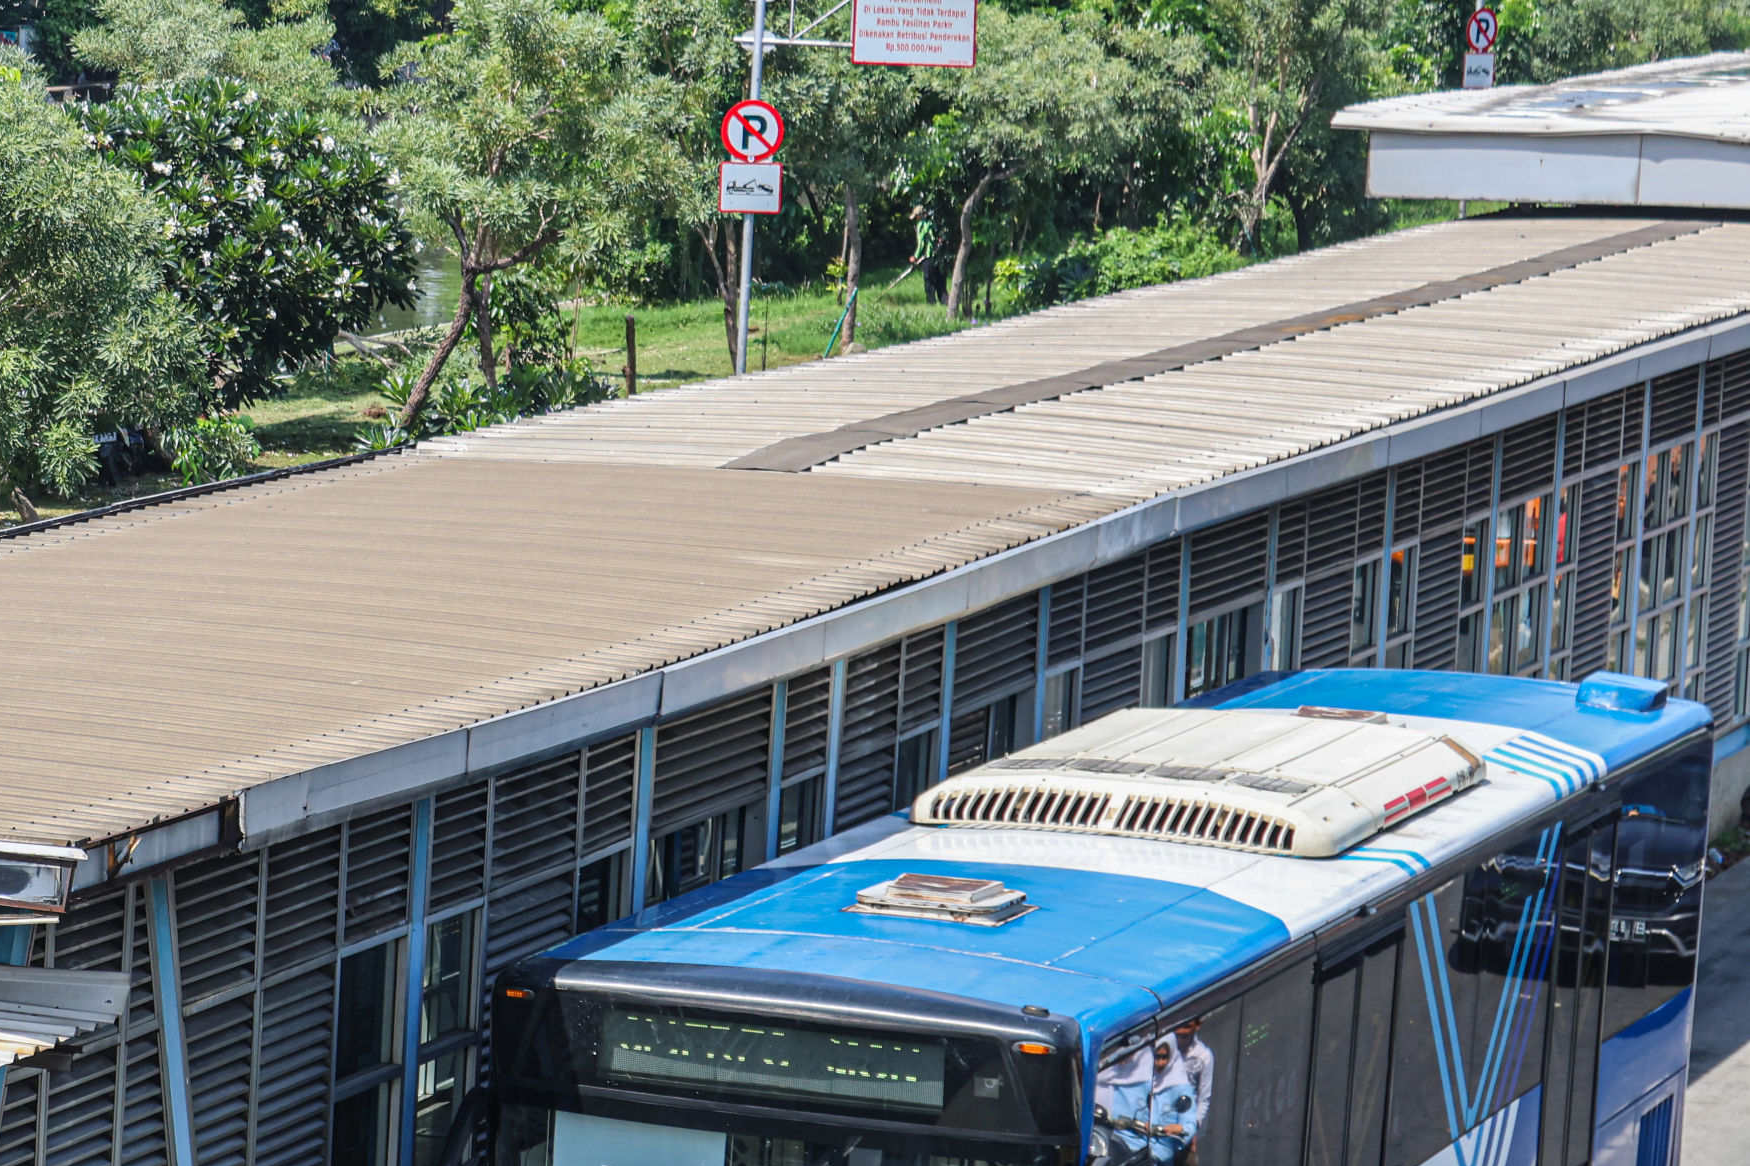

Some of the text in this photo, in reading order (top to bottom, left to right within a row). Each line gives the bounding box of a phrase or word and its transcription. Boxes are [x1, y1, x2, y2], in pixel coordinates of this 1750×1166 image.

[864, 6, 967, 19] Di Lokasi Yang Tidak Terdapat
[877, 18, 953, 29] Rambu Fasilitas Parkir
[859, 29, 970, 42] Dikenakan Retribusi Penderekan
[886, 43, 942, 53] Rp.500.000/Hari
